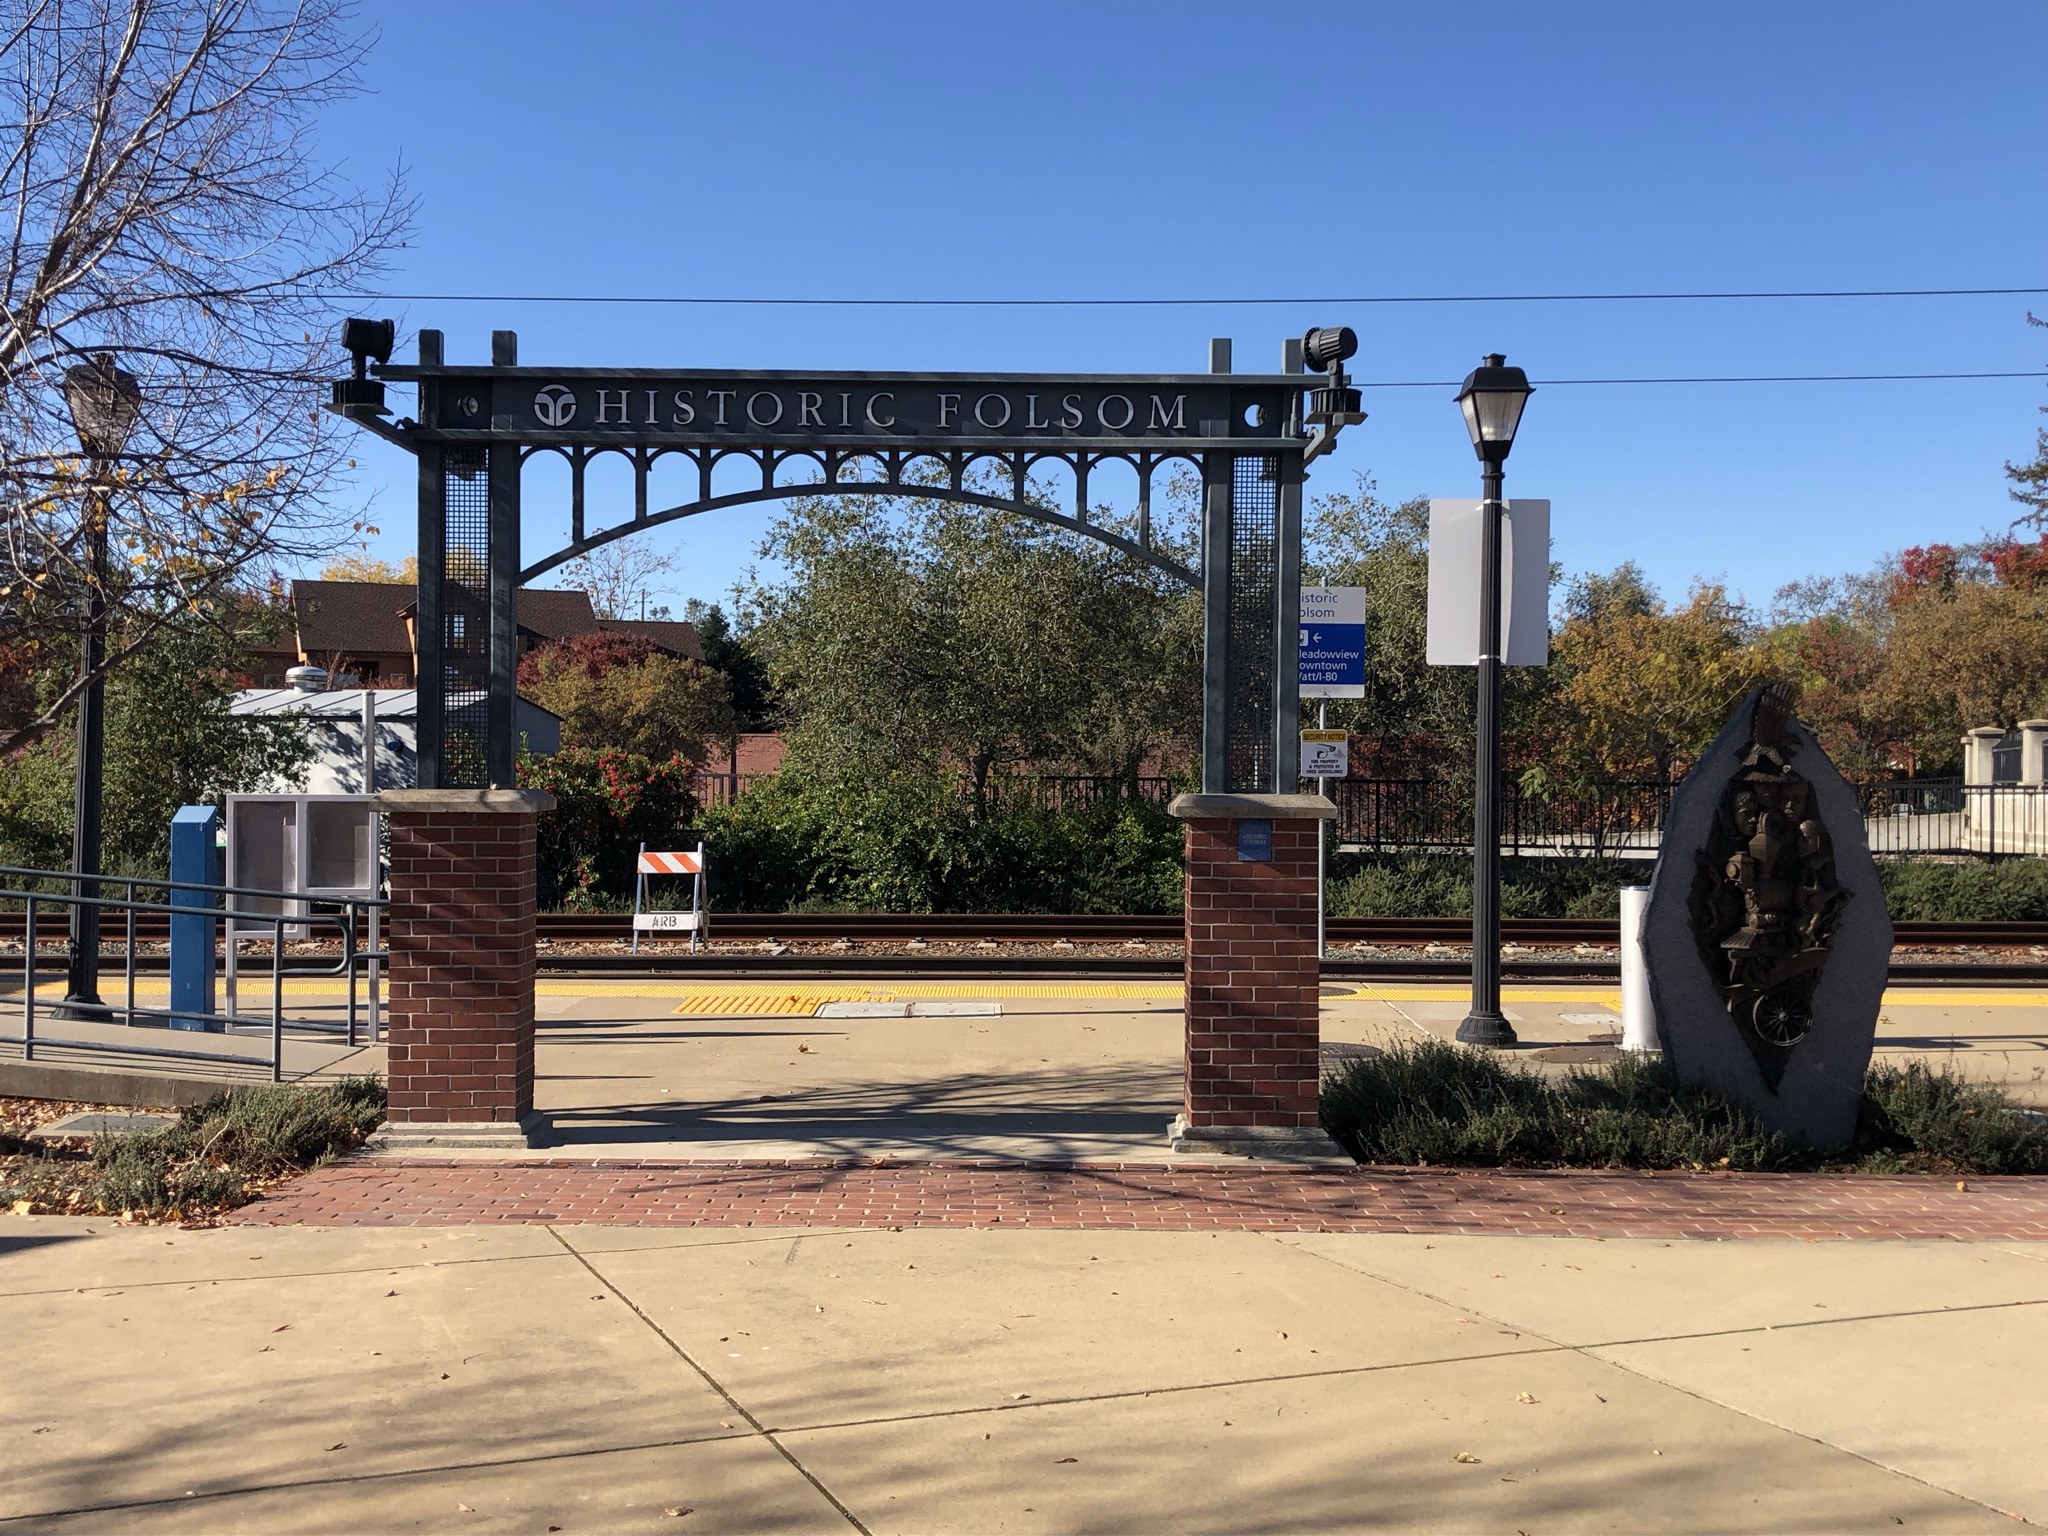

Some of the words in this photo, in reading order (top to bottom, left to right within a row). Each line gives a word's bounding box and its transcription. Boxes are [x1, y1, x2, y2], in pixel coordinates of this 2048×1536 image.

[595, 389, 896, 428] HISTORIC
[936, 393, 1188, 430] FOLSOM
[1302, 592, 1338, 603] istoric
[1299, 607, 1336, 618] olsom
[1299, 649, 1359, 659] eadowview
[1299, 661, 1347, 671] owntown
[1299, 671, 1337, 681] att/I-80
[652, 915, 677, 927] ARB
